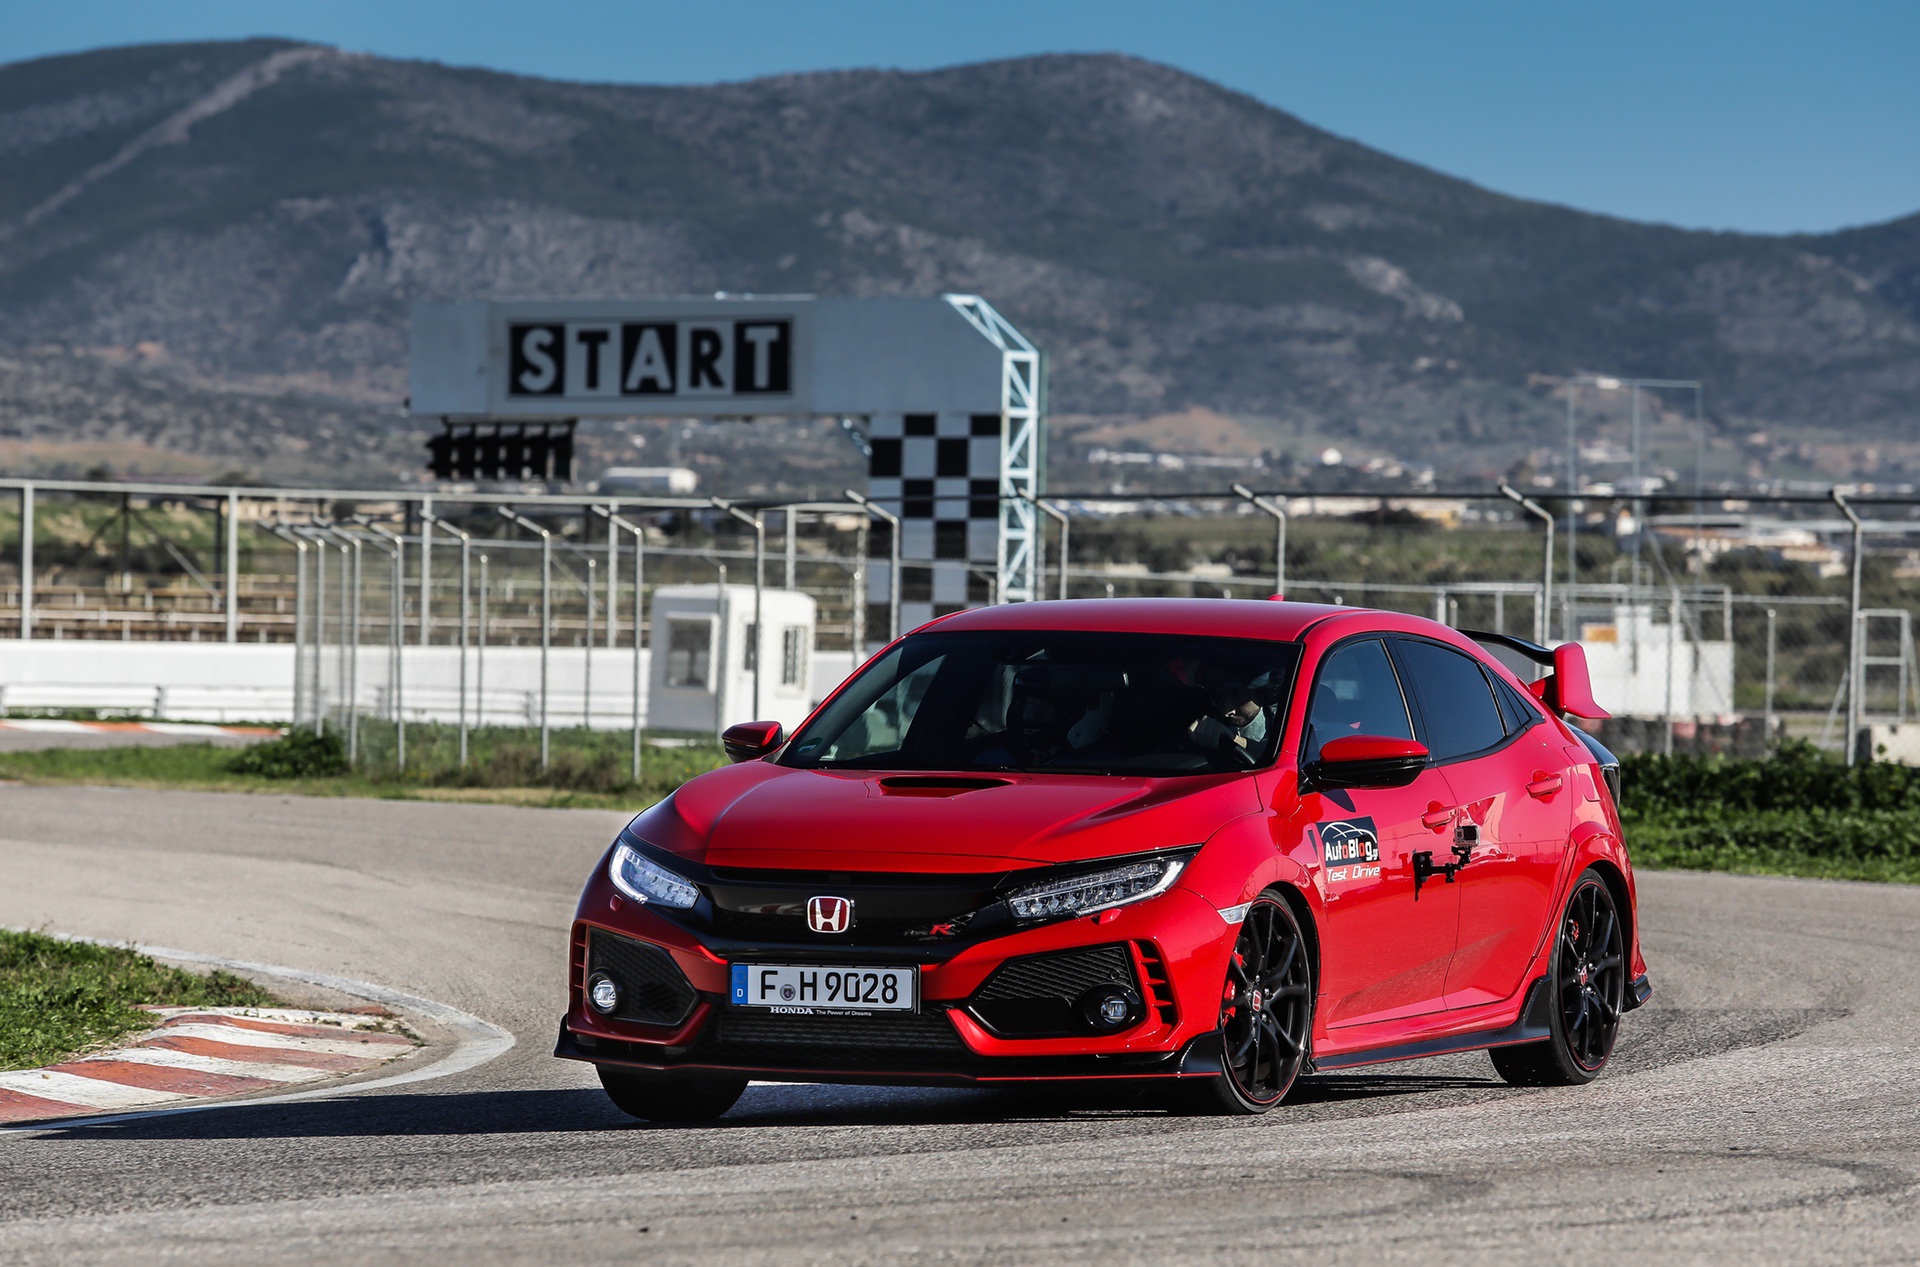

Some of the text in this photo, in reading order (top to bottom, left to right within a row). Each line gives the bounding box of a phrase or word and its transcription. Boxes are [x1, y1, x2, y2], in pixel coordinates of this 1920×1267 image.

[518, 325, 780, 392] START
[1327, 864, 1381, 882] Test Drive
[929, 923, 952, 935] R
[736, 988, 744, 998] D
[769, 1006, 814, 1015] HONDA
